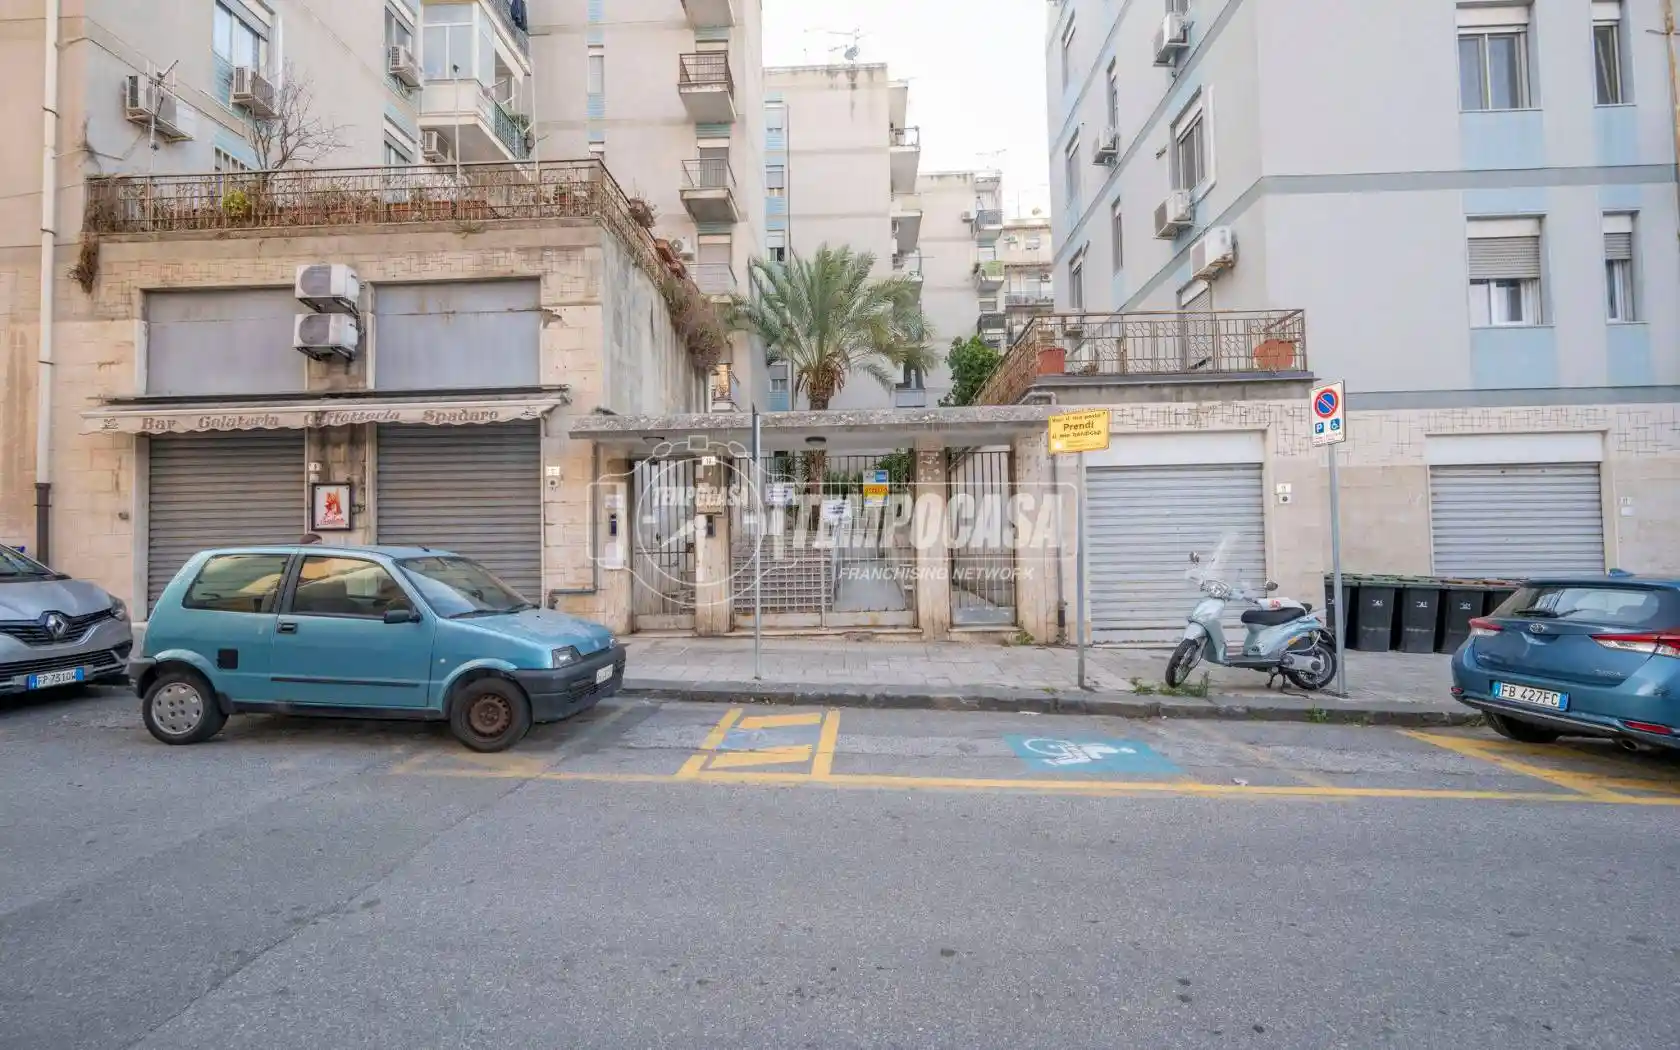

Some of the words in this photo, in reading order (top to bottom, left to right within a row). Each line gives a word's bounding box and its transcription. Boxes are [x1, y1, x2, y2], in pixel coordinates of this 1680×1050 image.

[141, 417, 176, 430] Bar
[421, 408, 499, 424] Spadaro
[1063, 421, 1094, 431] Prendi
[1502, 685, 1516, 698] FB
